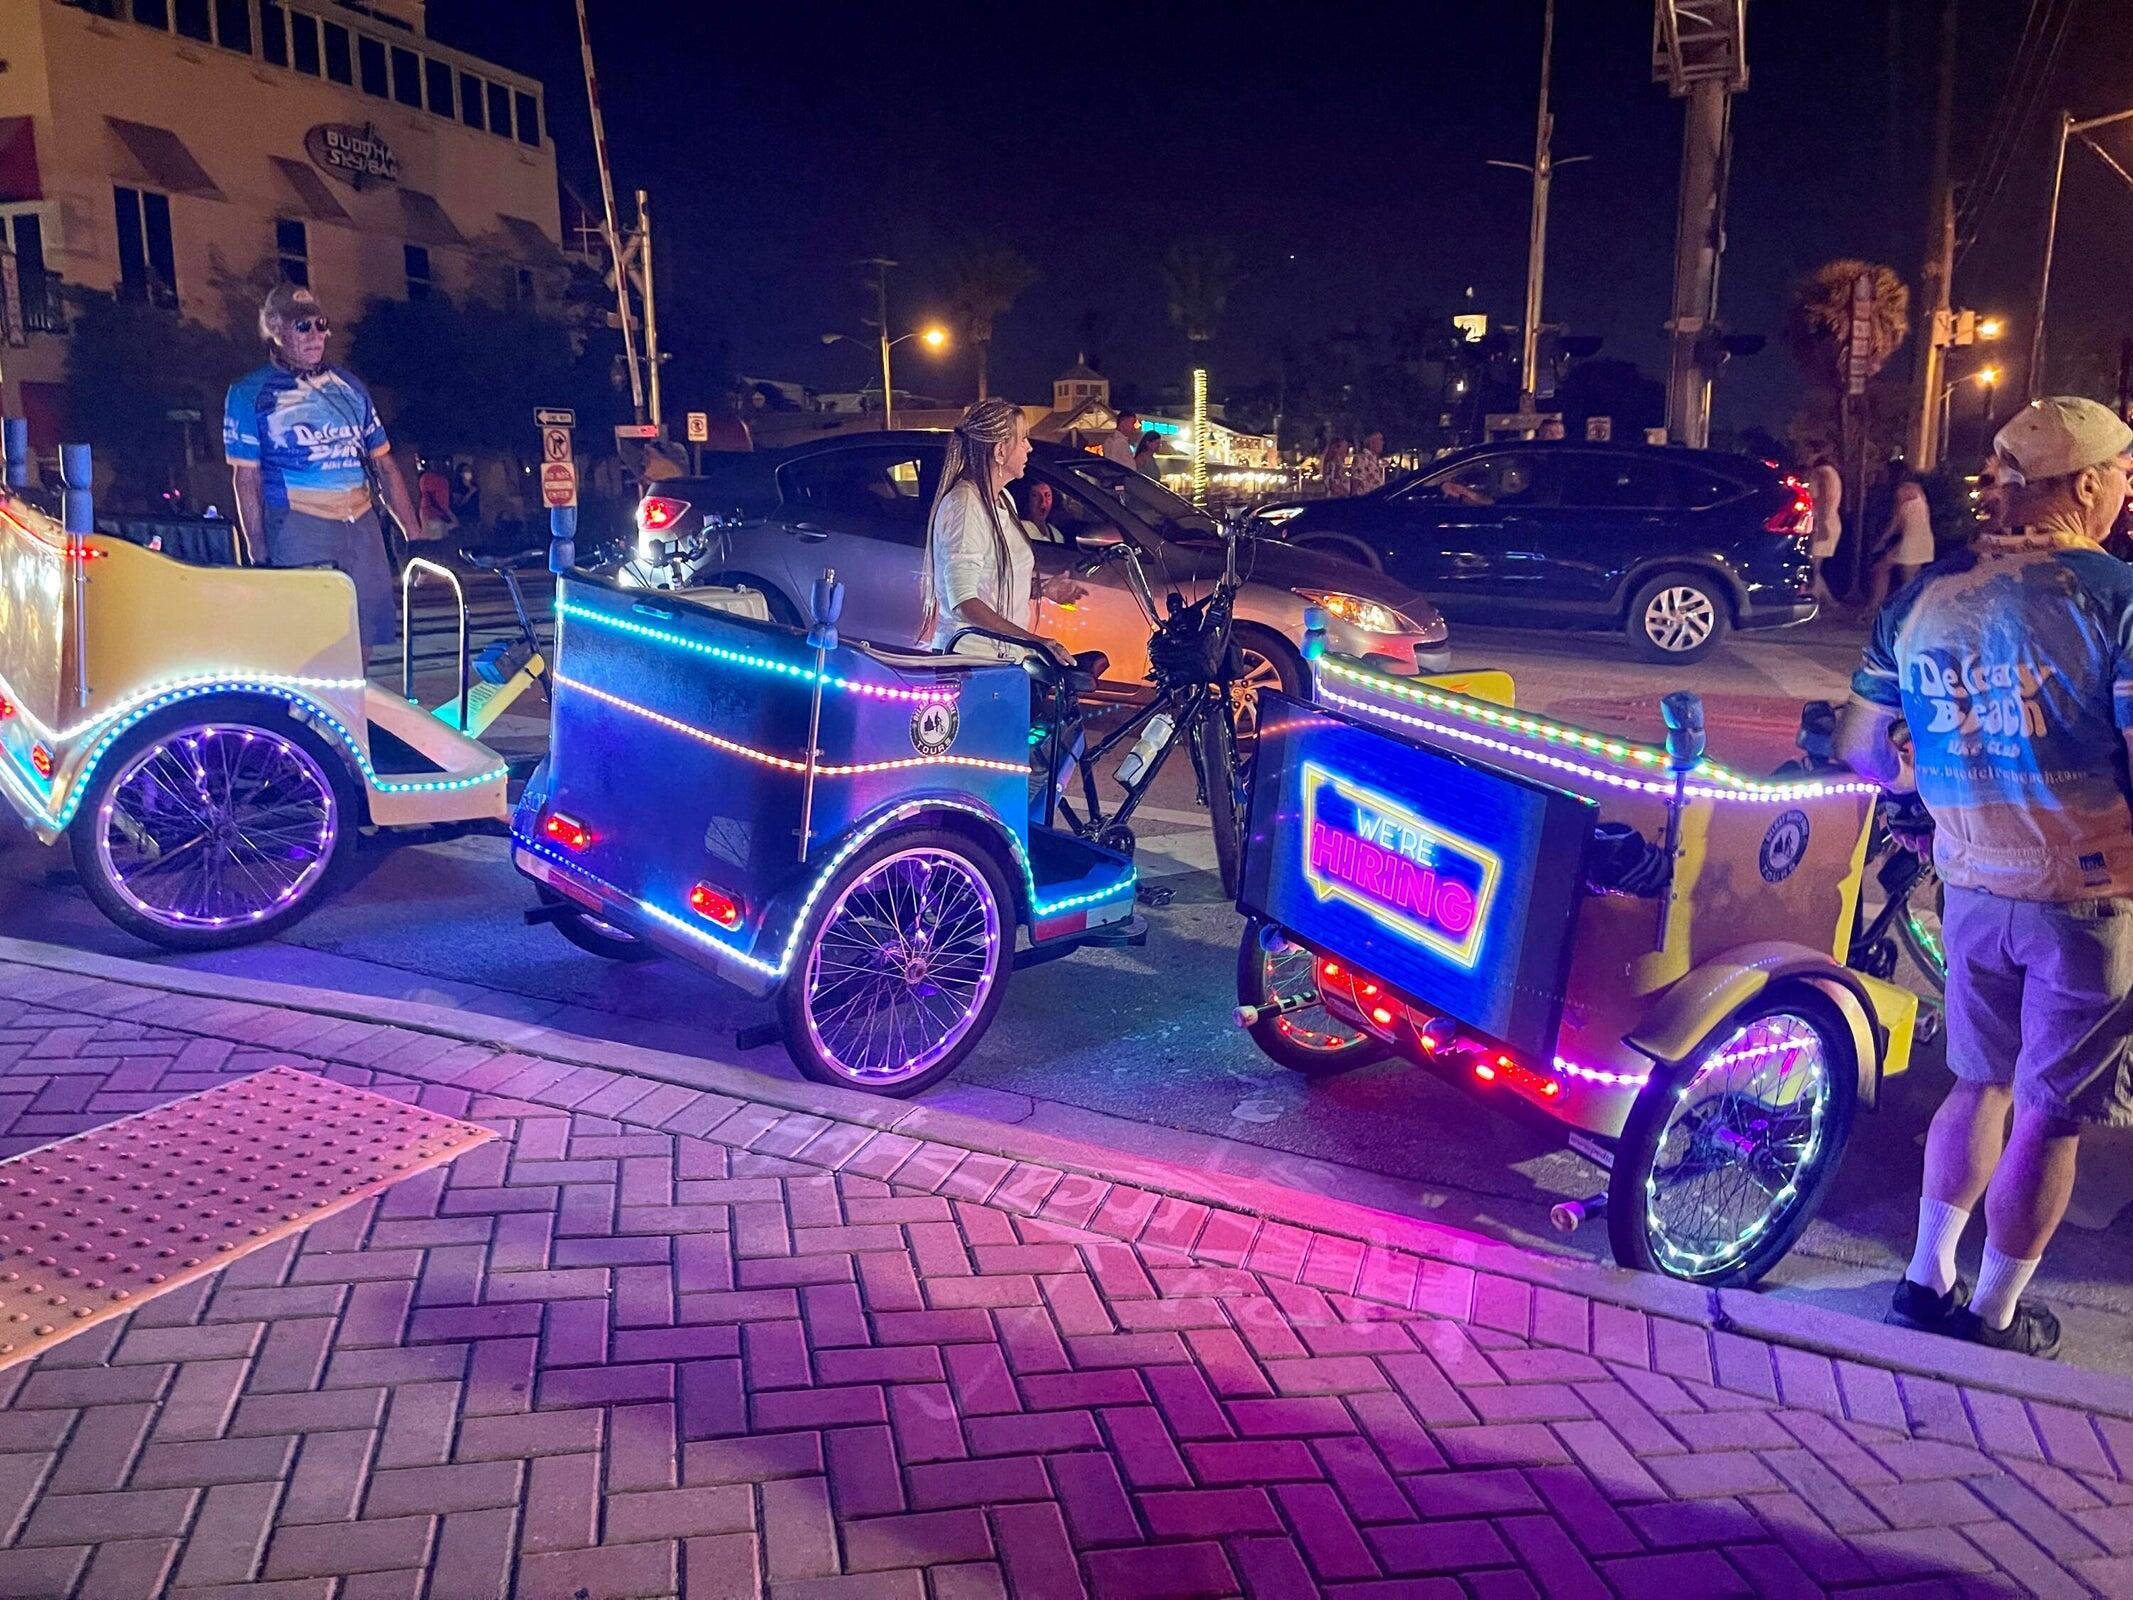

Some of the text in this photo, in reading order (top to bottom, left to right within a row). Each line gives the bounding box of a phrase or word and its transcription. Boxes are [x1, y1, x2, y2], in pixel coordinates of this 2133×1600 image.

[1919, 651, 2058, 698] Delray
[1927, 688, 2047, 737] Beach
[917, 738, 951, 754] TOURS
[1356, 808, 1437, 867] WE'RE
[1312, 822, 1473, 932] HIRING
